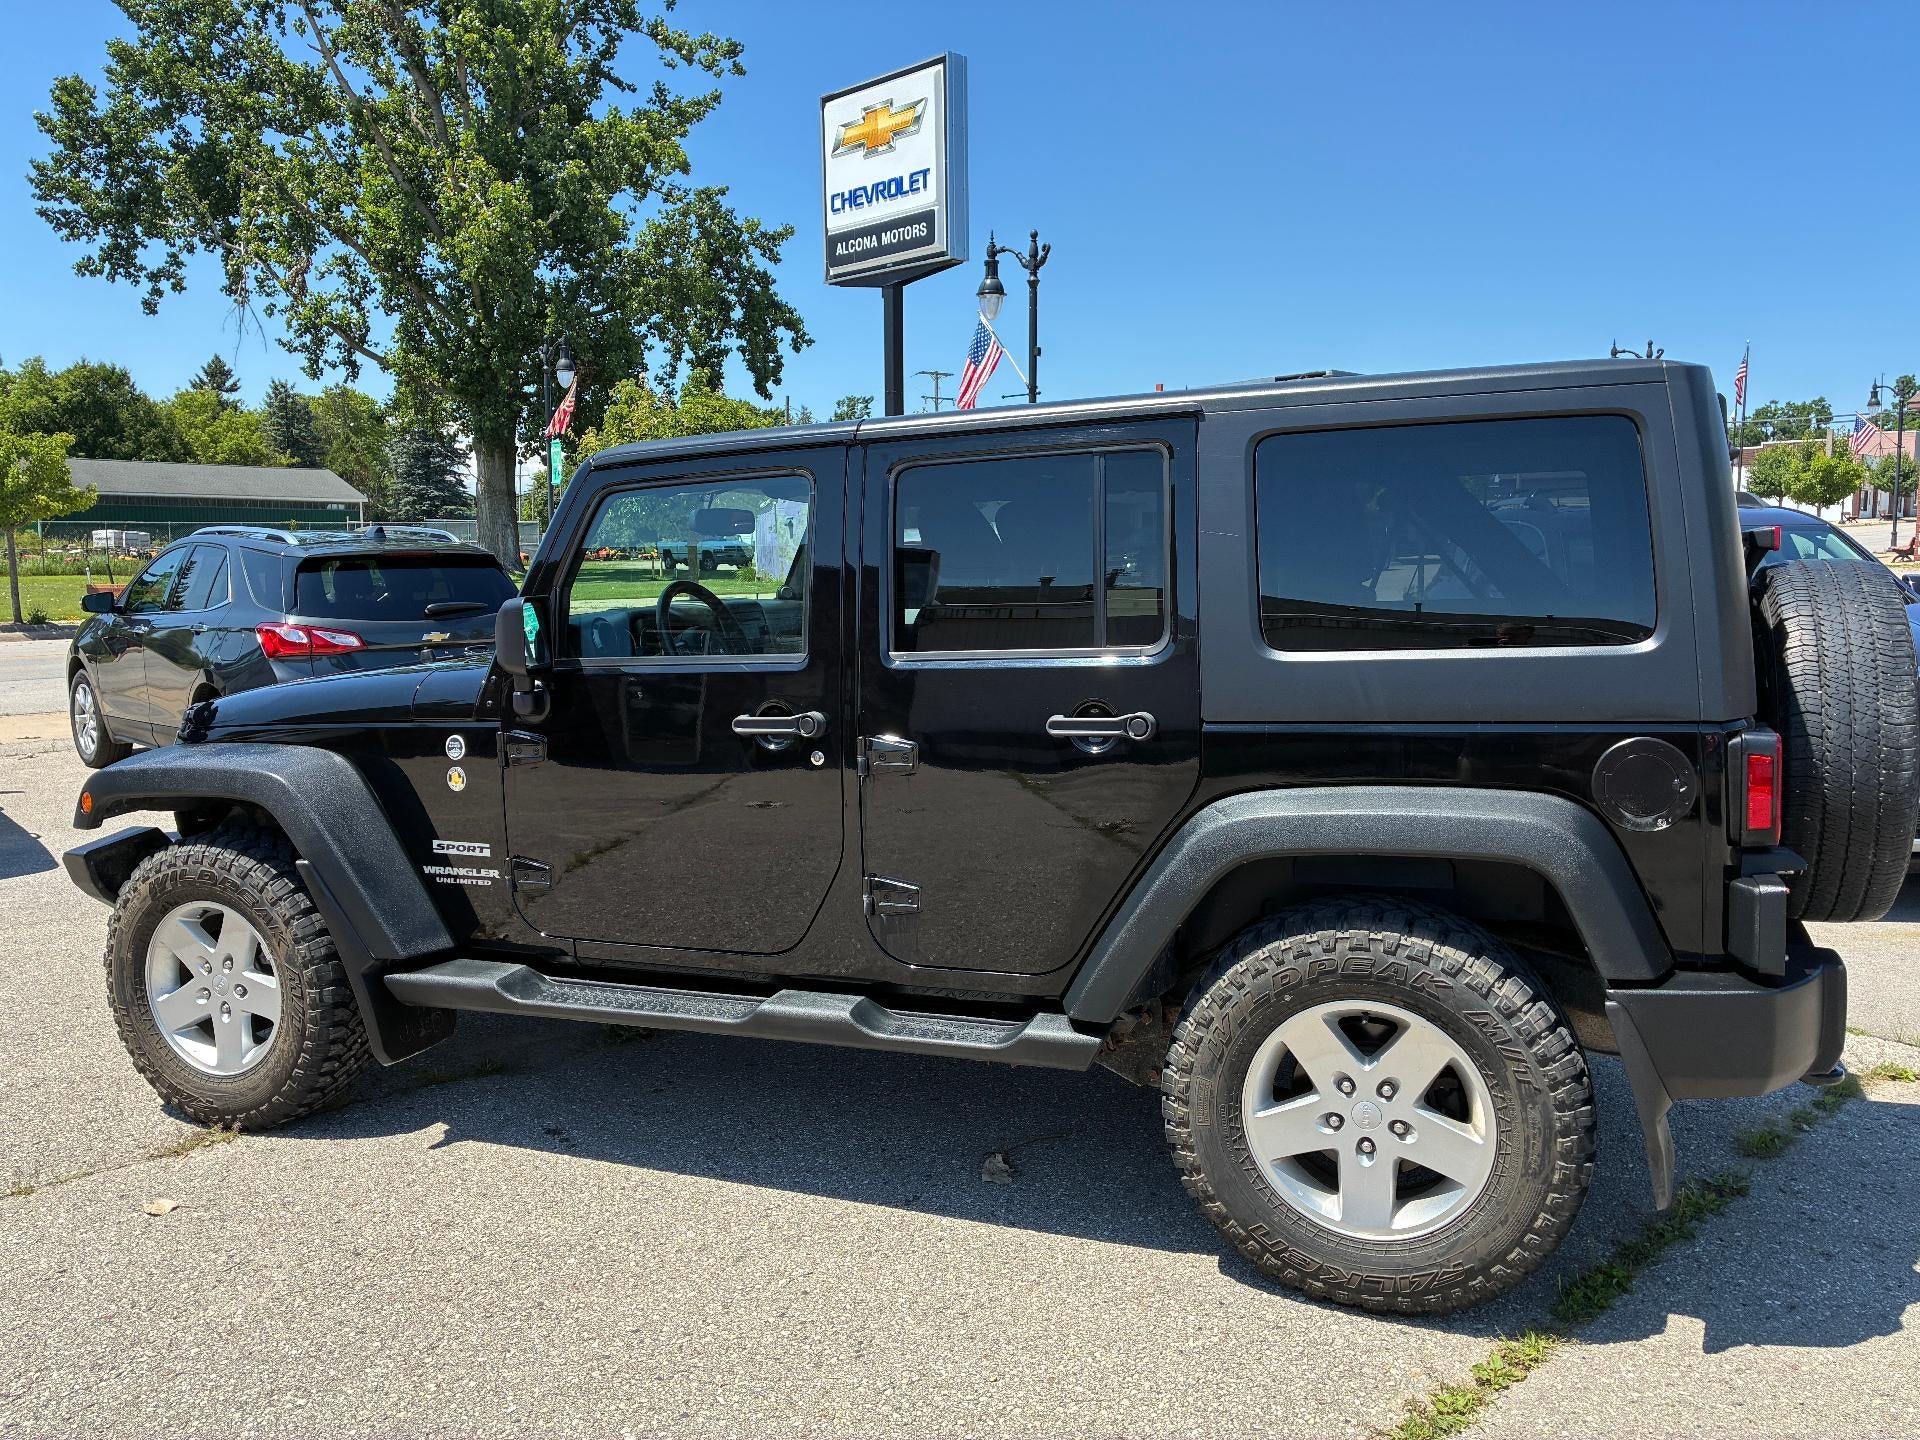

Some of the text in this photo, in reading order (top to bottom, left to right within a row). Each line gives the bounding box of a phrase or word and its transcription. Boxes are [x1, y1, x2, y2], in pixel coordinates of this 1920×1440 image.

[831, 168, 930, 213] CHEVROLET
[836, 222, 927, 256] ALCONA MOTORS
[436, 843, 487, 853] SPORT
[423, 865, 500, 878] WRANGLER
[436, 877, 491, 886] UNLIMITED
[1208, 956, 1453, 1059] WILDPEAK
[1249, 1222, 1475, 1294] FALKEN
